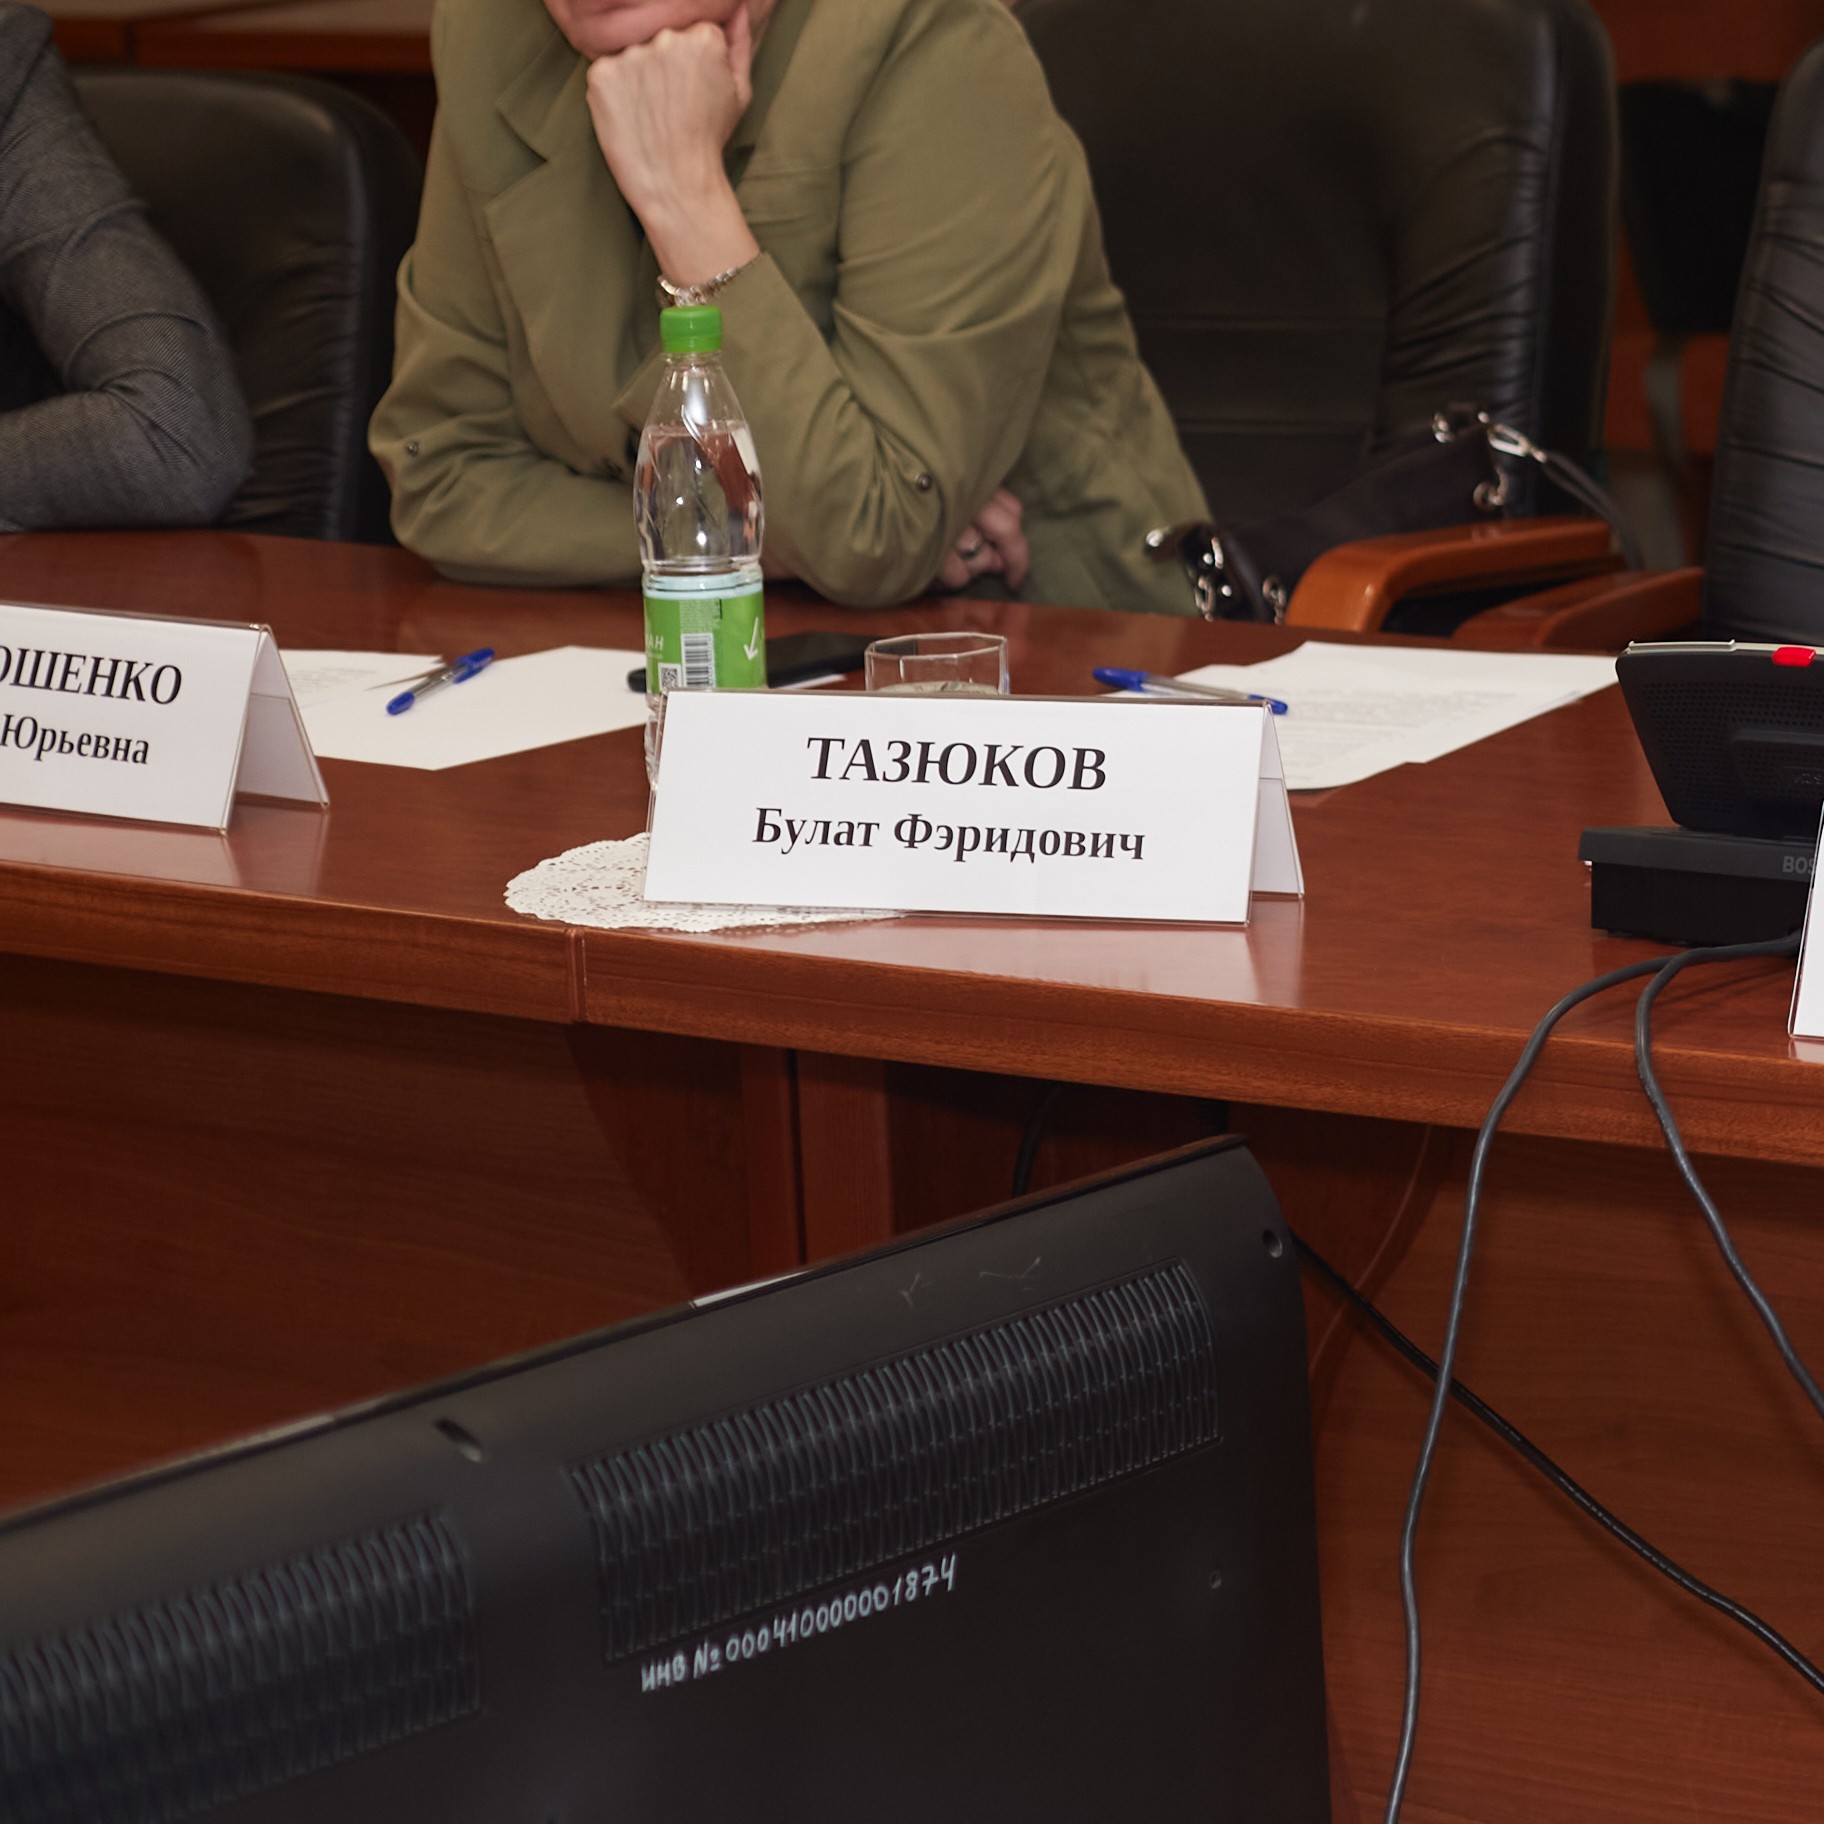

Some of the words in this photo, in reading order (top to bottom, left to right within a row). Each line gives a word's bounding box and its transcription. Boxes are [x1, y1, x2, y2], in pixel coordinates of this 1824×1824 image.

[0, 713, 150, 765] Юрьевна
[806, 737, 1107, 791] ТАЗЮКОВ
[752, 807, 880, 855] Булат
[893, 813, 1146, 864] Фэридович
[641, 1653, 688, 1692] ИНВ
